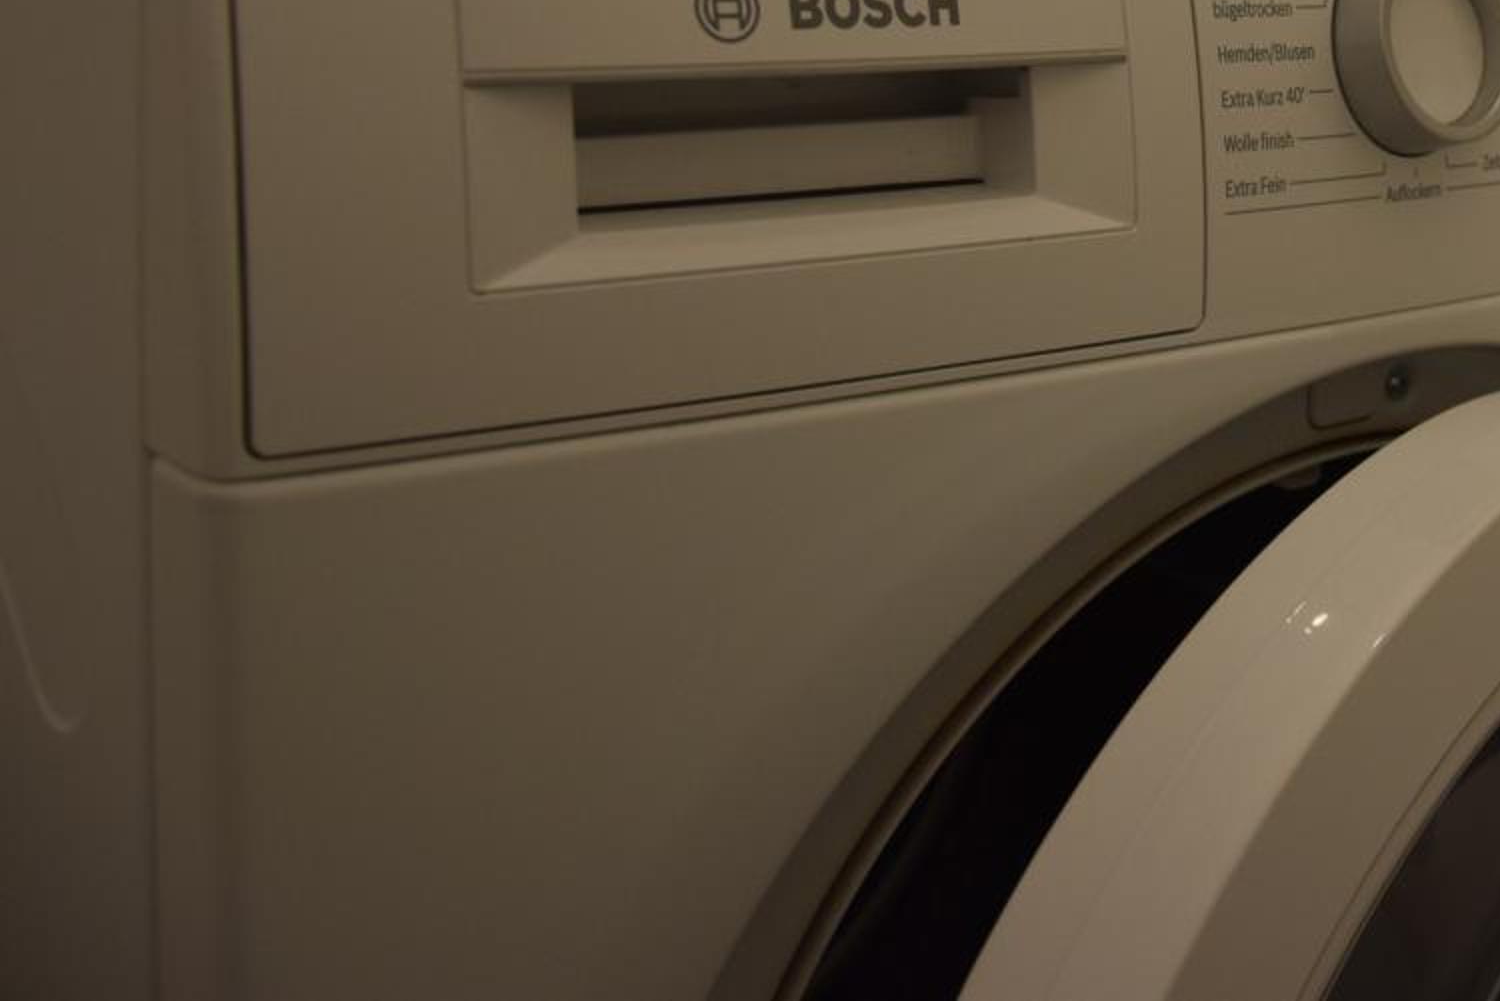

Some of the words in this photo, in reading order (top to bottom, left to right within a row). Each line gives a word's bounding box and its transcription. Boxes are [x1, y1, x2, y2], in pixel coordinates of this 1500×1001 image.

[1212, 0, 1293, 22] bügeltrocken
[1217, 42, 1316, 65] Hemden/Blusen
[1221, 90, 1254, 108] Extra
[1257, 88, 1283, 107] Kurz
[1224, 133, 1258, 152] Wolle
[1261, 131, 1295, 150] finish
[1225, 179, 1258, 199] Extra
[1260, 176, 1287, 195] Fein
